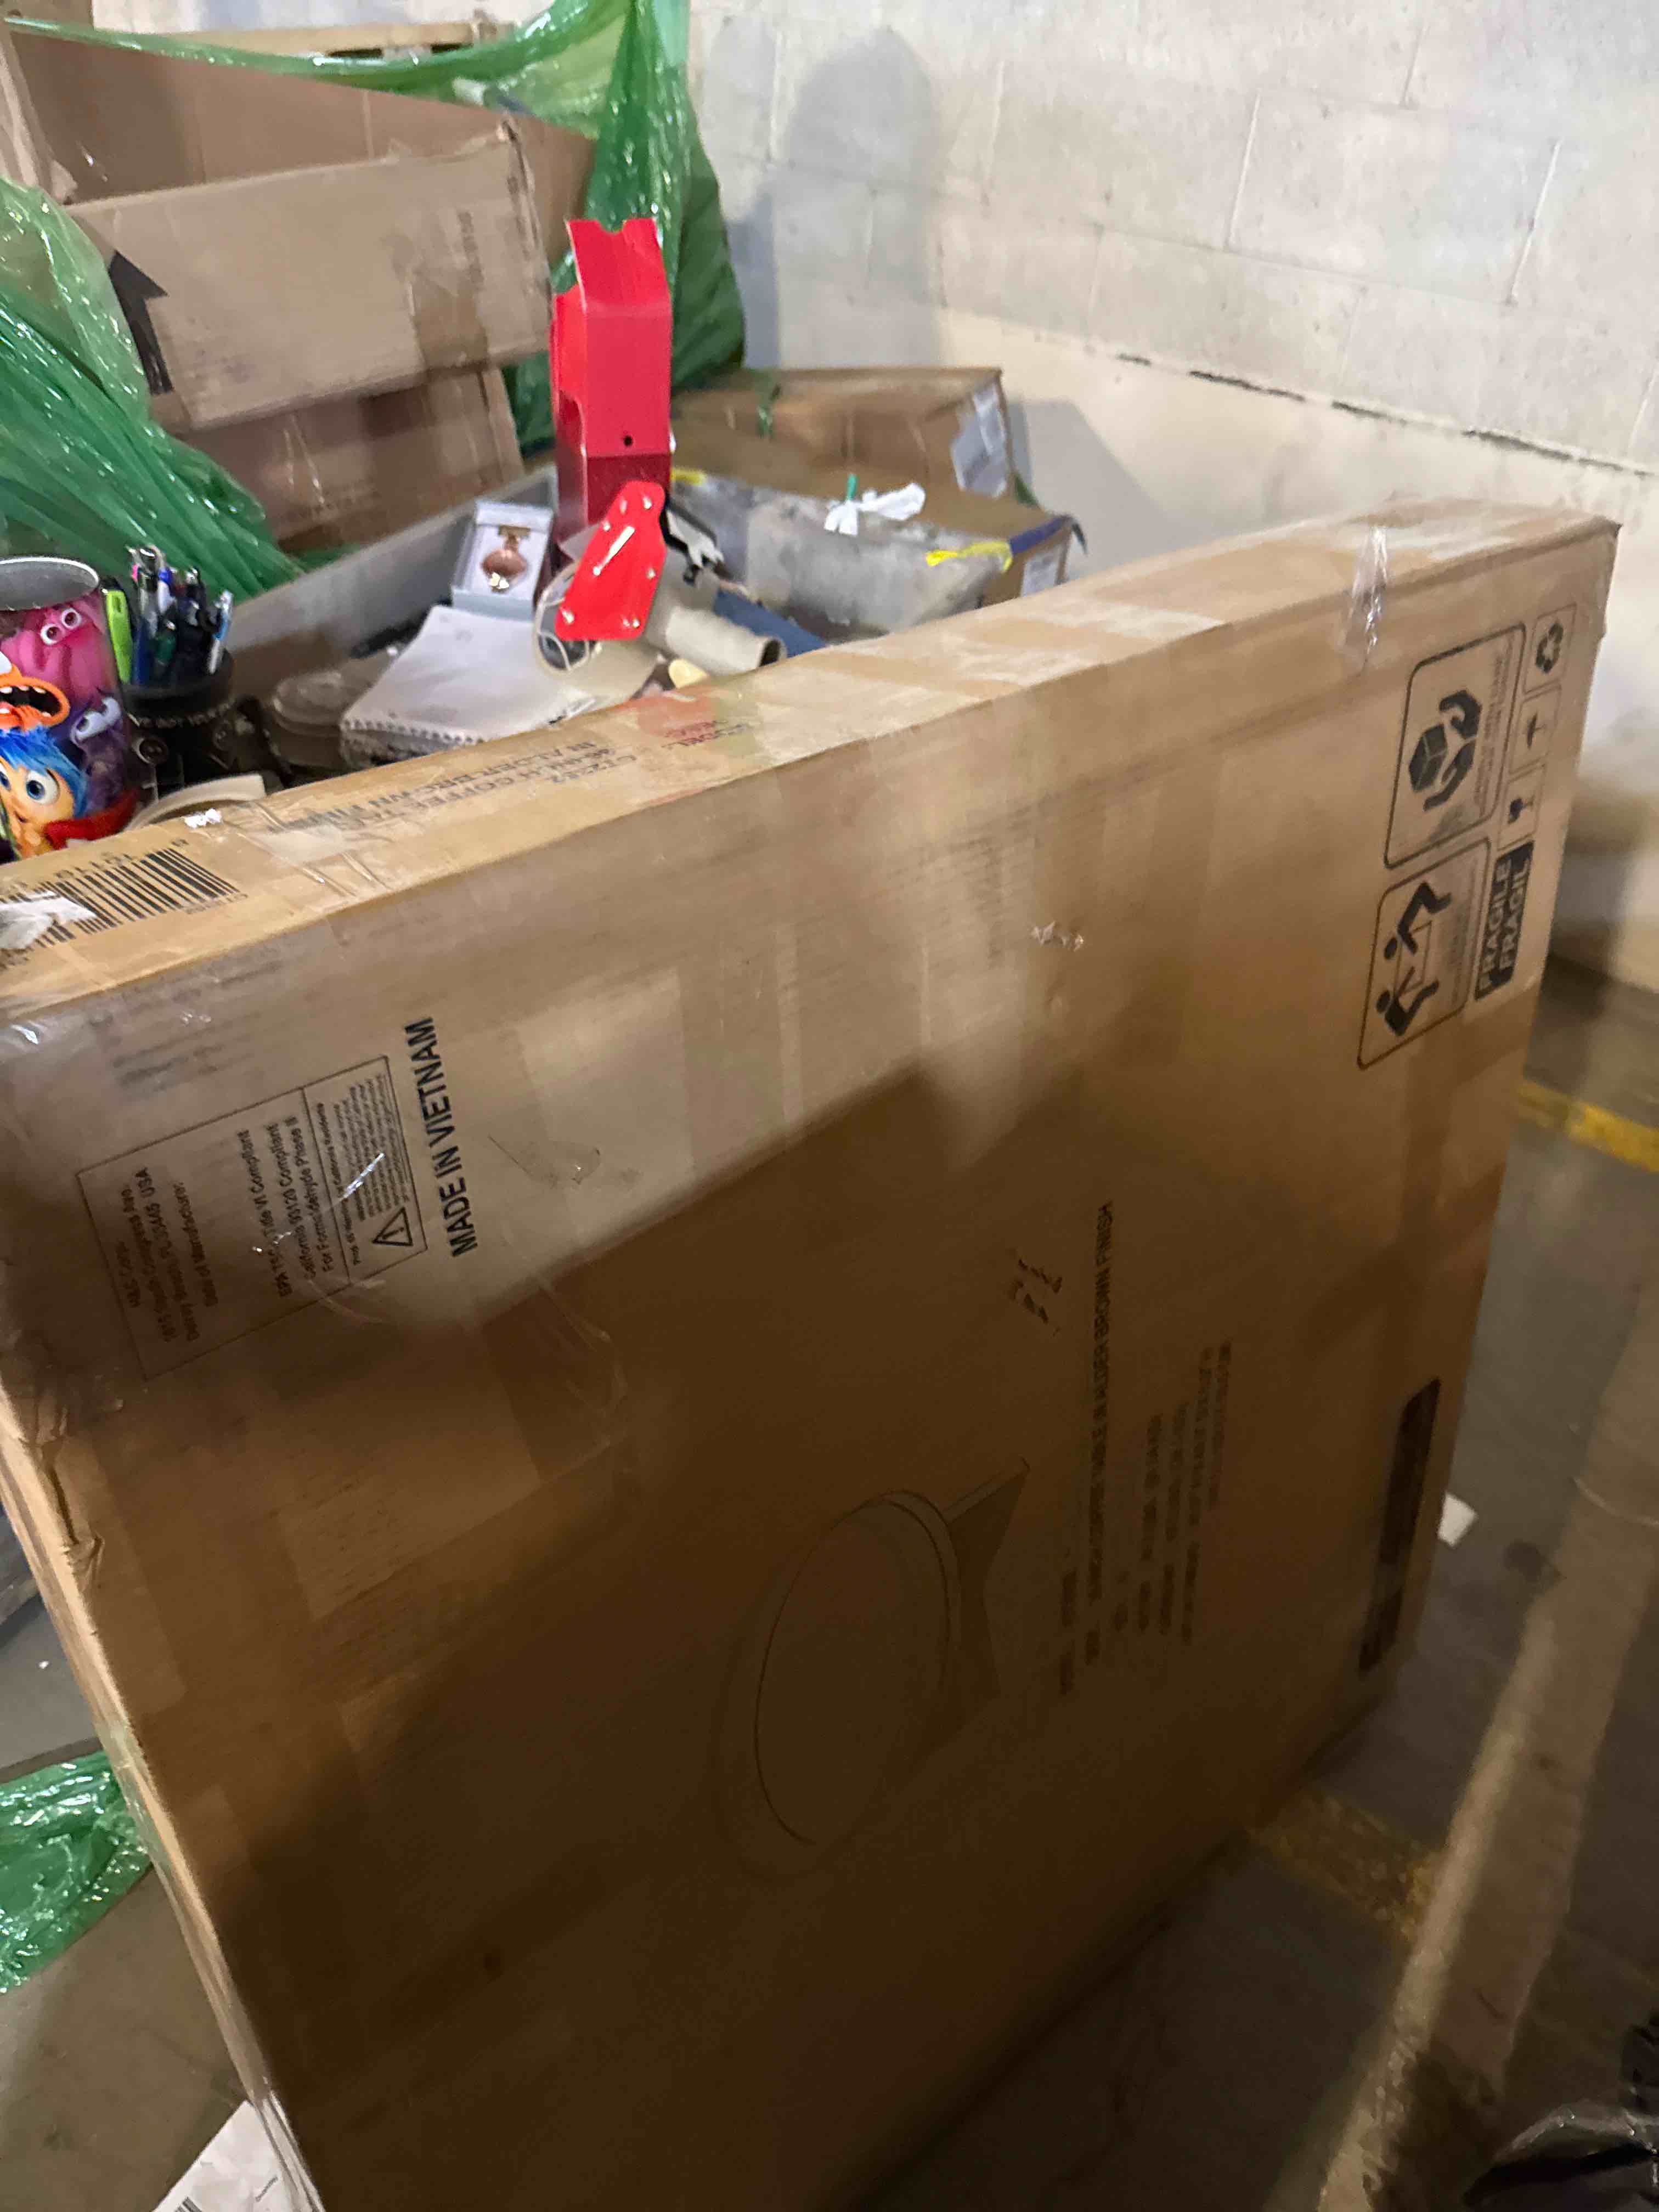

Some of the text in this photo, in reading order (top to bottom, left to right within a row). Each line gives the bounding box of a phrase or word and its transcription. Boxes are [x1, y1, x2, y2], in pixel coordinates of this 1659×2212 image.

[1477, 856, 1511, 990] FRAGILE
[1499, 856, 1530, 969] FRAGIL
[237, 1130, 264, 1194] Compliant
[265, 1124, 292, 1187] Compliant
[290, 1128, 309, 1167] Phase
[405, 1017, 478, 1258] MADE IN VIETNAM
[135, 1167, 155, 1198] USA
[252, 1195, 268, 1210] VI
[282, 1188, 302, 1224] 93120
[299, 1168, 329, 1251] Formaldehyde
[321, 1252, 334, 1272] For
[1094, 1199, 1113, 1268] FINISH
[275, 1272, 293, 1297] EPA
[1093, 1267, 1111, 1341] BROWN
